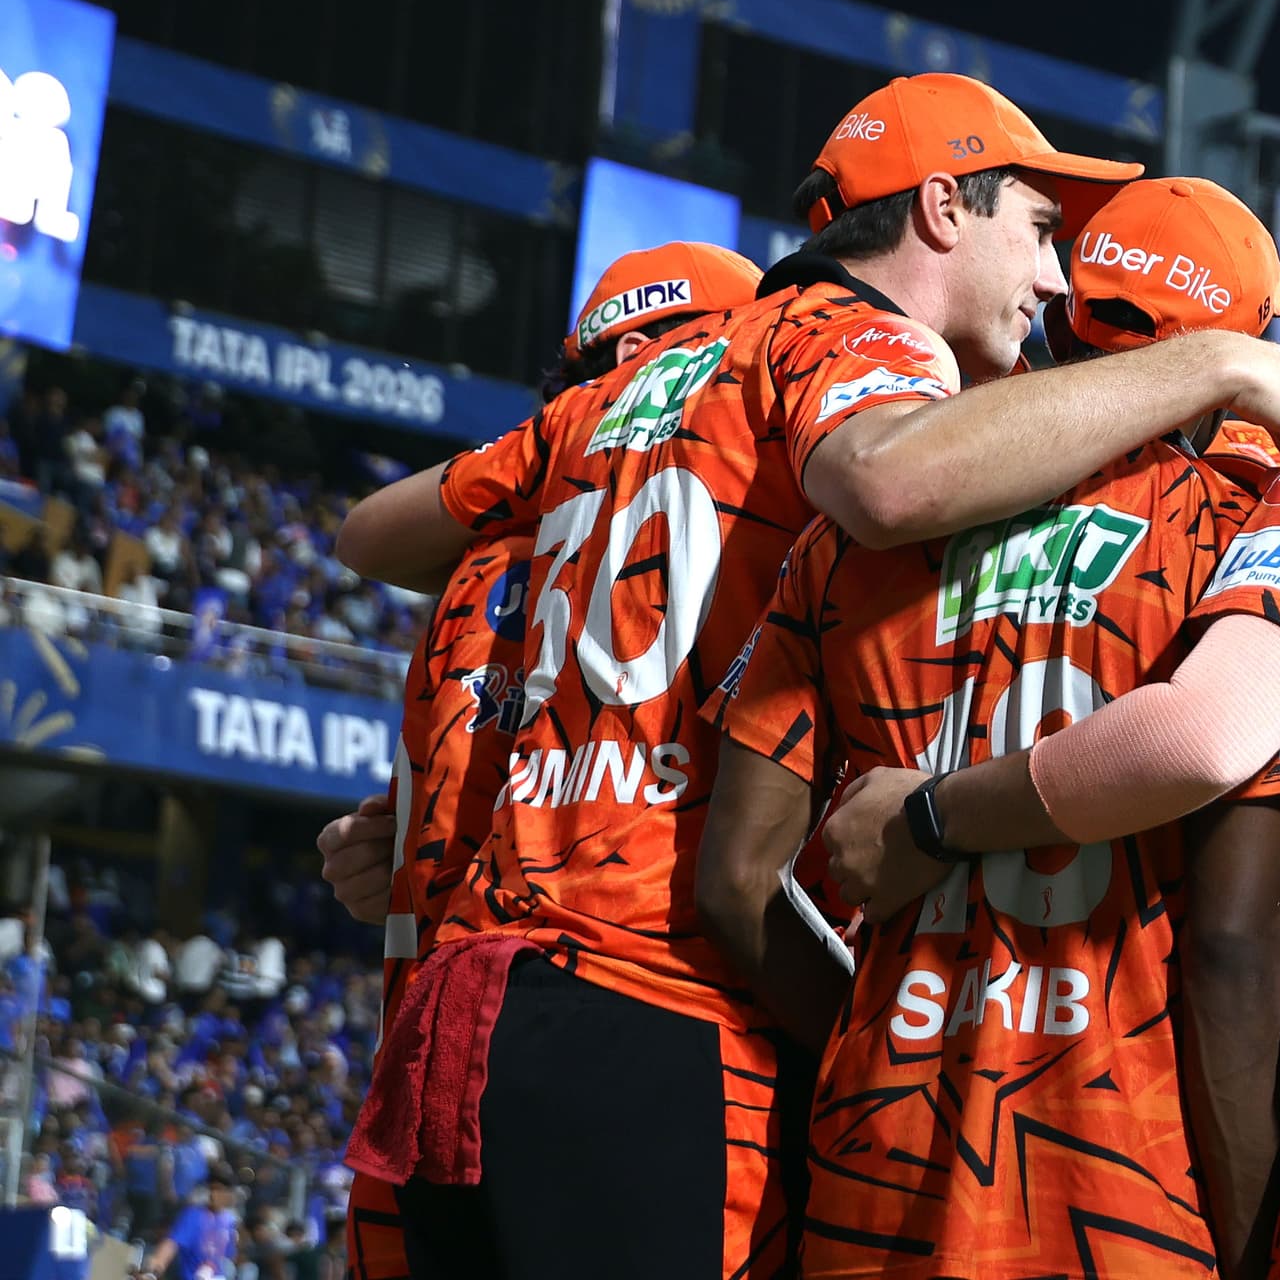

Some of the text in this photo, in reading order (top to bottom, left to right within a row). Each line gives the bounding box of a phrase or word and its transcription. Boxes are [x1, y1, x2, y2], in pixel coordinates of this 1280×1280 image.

[836, 112, 885, 141] Bike
[947, 134, 985, 159] 30
[1080, 231, 1231, 314] Uber Bike
[579, 280, 688, 346] ECOLINK
[1258, 295, 1272, 325] 18
[852, 327, 932, 352] AirAs
[171, 315, 444, 423] TATA IPL 2026
[629, 416, 681, 447] TYES
[1024, 593, 1092, 621] TYES
[190, 687, 392, 782] TATA IPL
[891, 958, 1091, 1041] SAKIB
